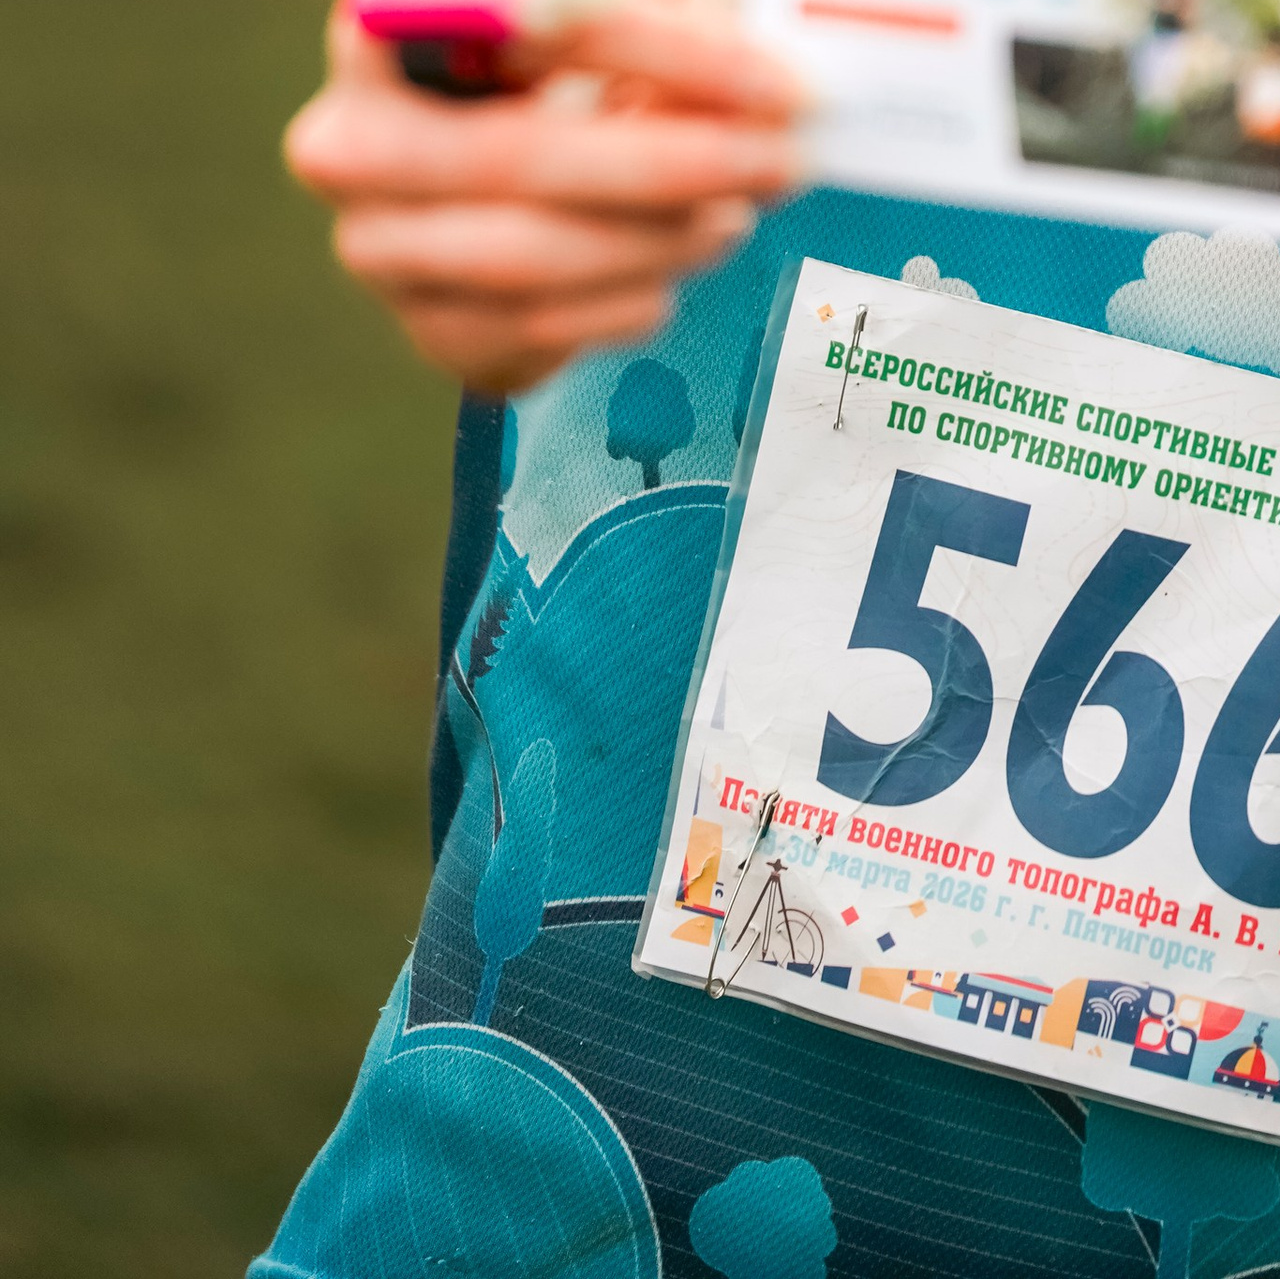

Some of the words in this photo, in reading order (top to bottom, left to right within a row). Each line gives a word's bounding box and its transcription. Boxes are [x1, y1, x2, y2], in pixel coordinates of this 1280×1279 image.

[824, 341, 1069, 425] ВСЕРОССИЙСКИЕ
[1076, 403, 1278, 477] СПОРТИВНЫЕ
[887, 401, 928, 435] ПО
[936, 413, 1148, 490] СПОРТИВНОМУ
[719, 777, 839, 837] Паяти
[847, 817, 996, 879] военного
[1008, 858, 1181, 928] топографа
[1190, 903, 1222, 939] А.
[1235, 913, 1265, 952] В.
[826, 851, 911, 894] марта
[918, 872, 989, 913] 2026
[994, 895, 1017, 921] г.
[1028, 904, 1050, 930] г.
[1062, 908, 1215, 974] Пятигорск
